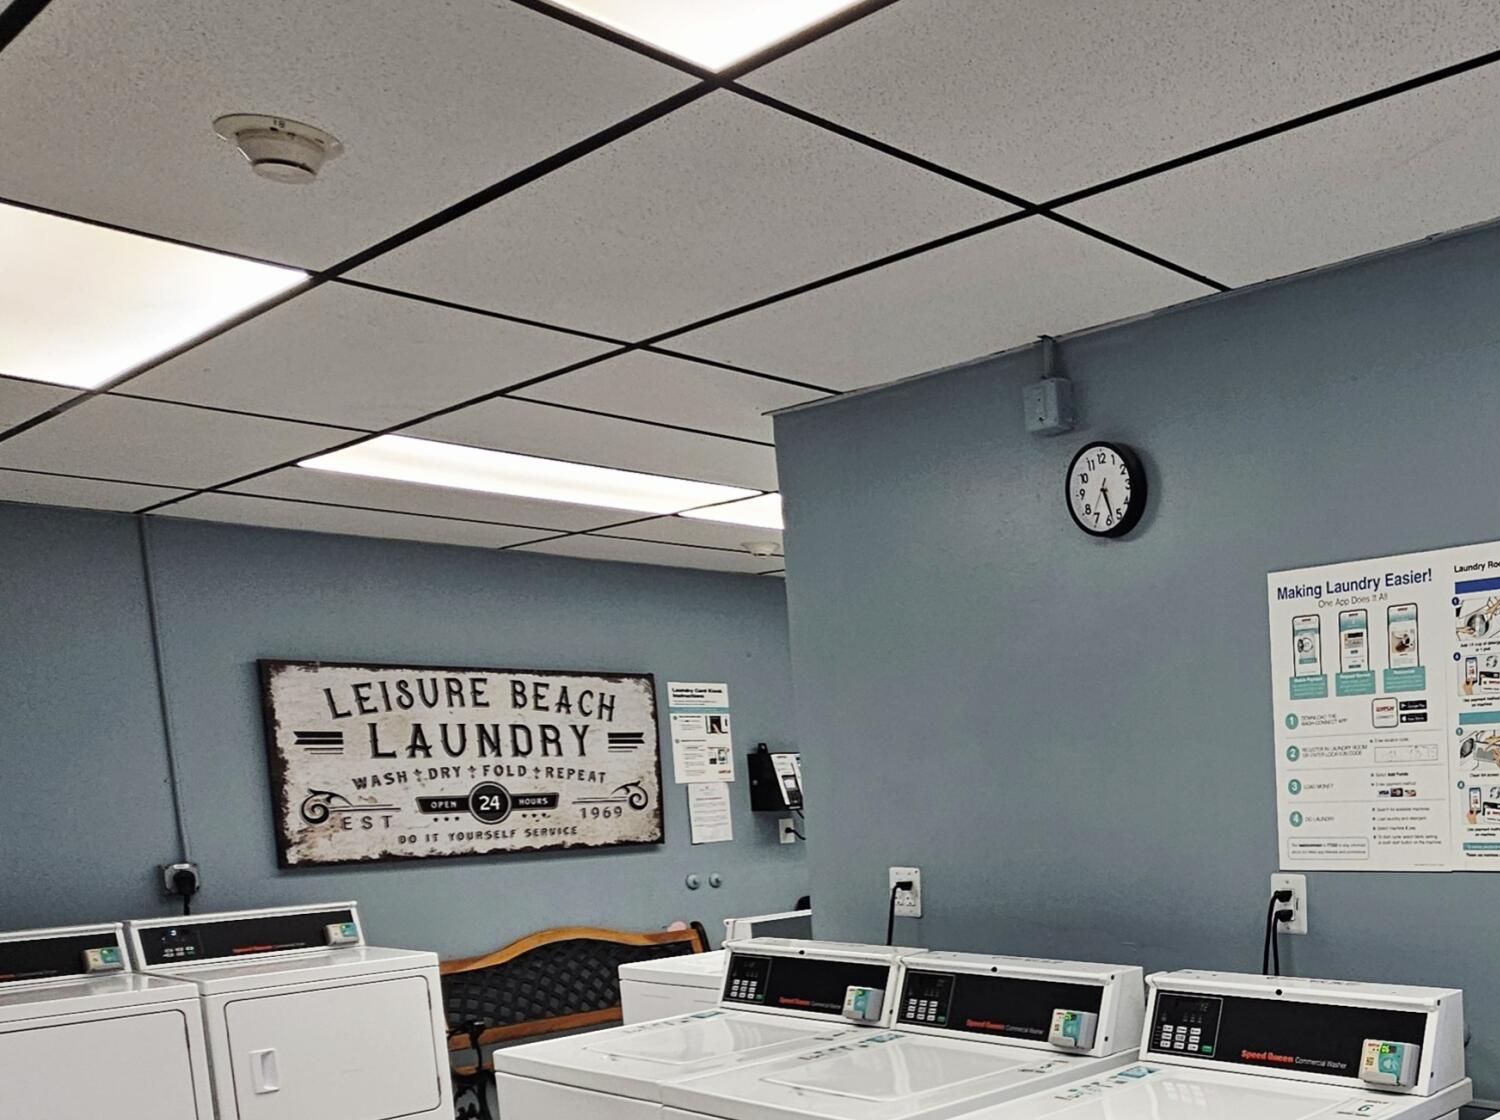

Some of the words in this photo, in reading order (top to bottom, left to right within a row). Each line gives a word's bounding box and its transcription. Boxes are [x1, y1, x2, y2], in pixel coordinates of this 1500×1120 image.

[1097, 453, 1106, 464] 12
[1111, 454, 1115, 465] 1
[1087, 459, 1095, 471] 11
[1120, 464, 1126, 475] 2
[1079, 473, 1088, 484] 10
[1125, 478, 1131, 490] 3
[1080, 489, 1086, 500] 9
[1085, 504, 1092, 515] 8
[1116, 508, 1122, 520] 5
[1094, 512, 1100, 524] 7
[1454, 562, 1486, 573] Laundry
[1277, 585, 1322, 600] Making
[1326, 575, 1381, 595] Laundry
[1385, 568, 1432, 587] Easier!
[1318, 599, 1333, 609] One
[1335, 598, 1350, 607] App
[1351, 595, 1371, 605] Does
[322, 677, 490, 720] LEISURE
[510, 679, 616, 722] BEACH
[1289, 717, 1295, 726] 1
[367, 722, 590, 759] LAUNDRY
[1290, 747, 1297, 758] 2
[352, 770, 408, 790] WASH
[428, 765, 461, 780] DRY
[483, 765, 527, 777] FOLD
[545, 766, 606, 784] REPEAT
[1292, 782, 1298, 792] 3
[430, 800, 457, 809] OPEN
[479, 795, 501, 811] 24
[518, 797, 549, 806] HOURS
[580, 805, 623, 819] 1969
[342, 815, 393, 830] EST
[1293, 814, 1299, 825] 4
[398, 834, 417, 844] DO
[425, 833, 439, 842] IT
[447, 829, 517, 842] YOURSELF
[524, 825, 578, 836] SERVICE
[1241, 1049, 1266, 1061] Speed
[1267, 1051, 1294, 1063] Queen
[1295, 1056, 1326, 1068] Commercial
[1326, 1060, 1347, 1069] Washer
